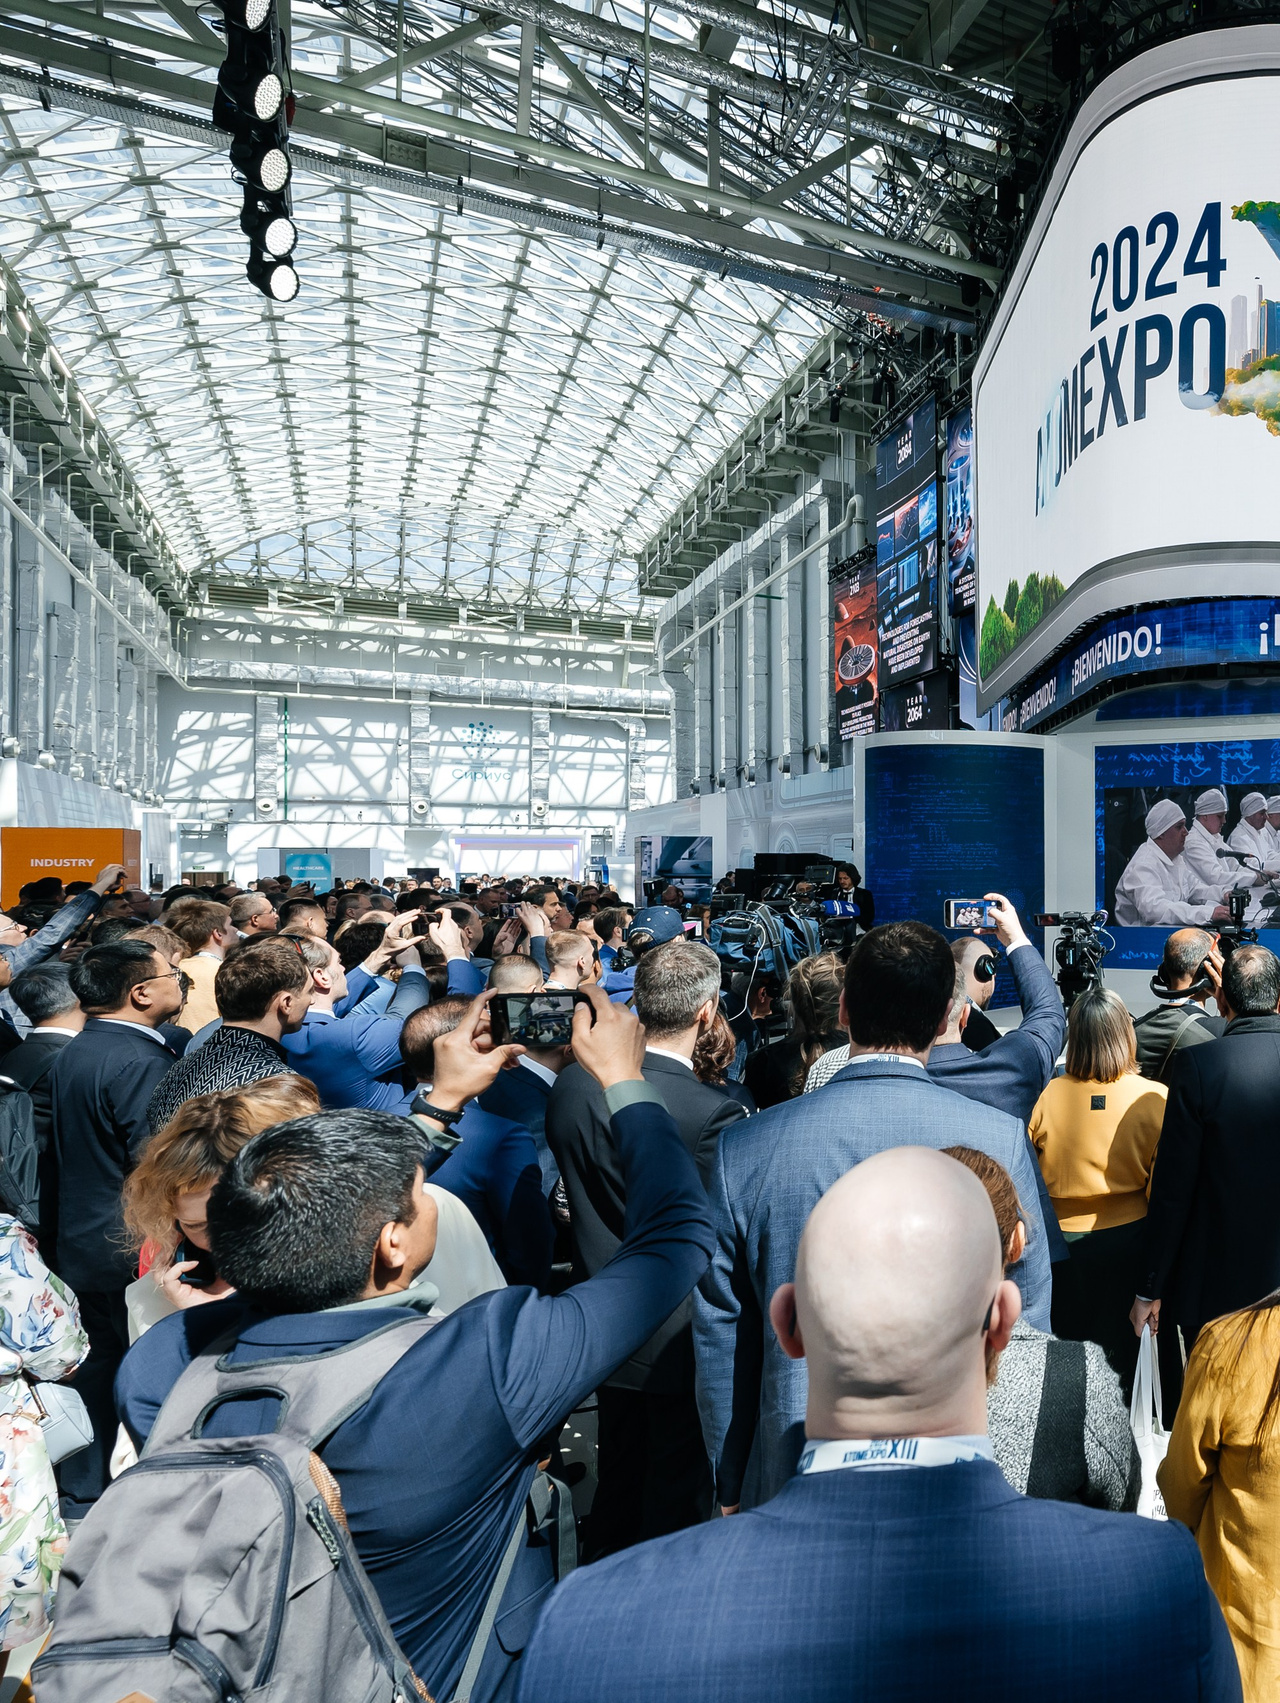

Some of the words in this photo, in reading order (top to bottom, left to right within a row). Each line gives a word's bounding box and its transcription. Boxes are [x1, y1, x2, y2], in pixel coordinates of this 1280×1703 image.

[1089, 200, 1226, 332] 2024
[1070, 622, 1163, 694] ¡BIENVENIDO!
[906, 695, 922, 706] YEAR
[907, 705, 922, 723] 2064
[452, 769, 511, 782] Сириус
[30, 858, 95, 867] INDUSTRY
[843, 1450, 886, 1463] ATOMEXPO
[888, 1440, 918, 1460] XIII
